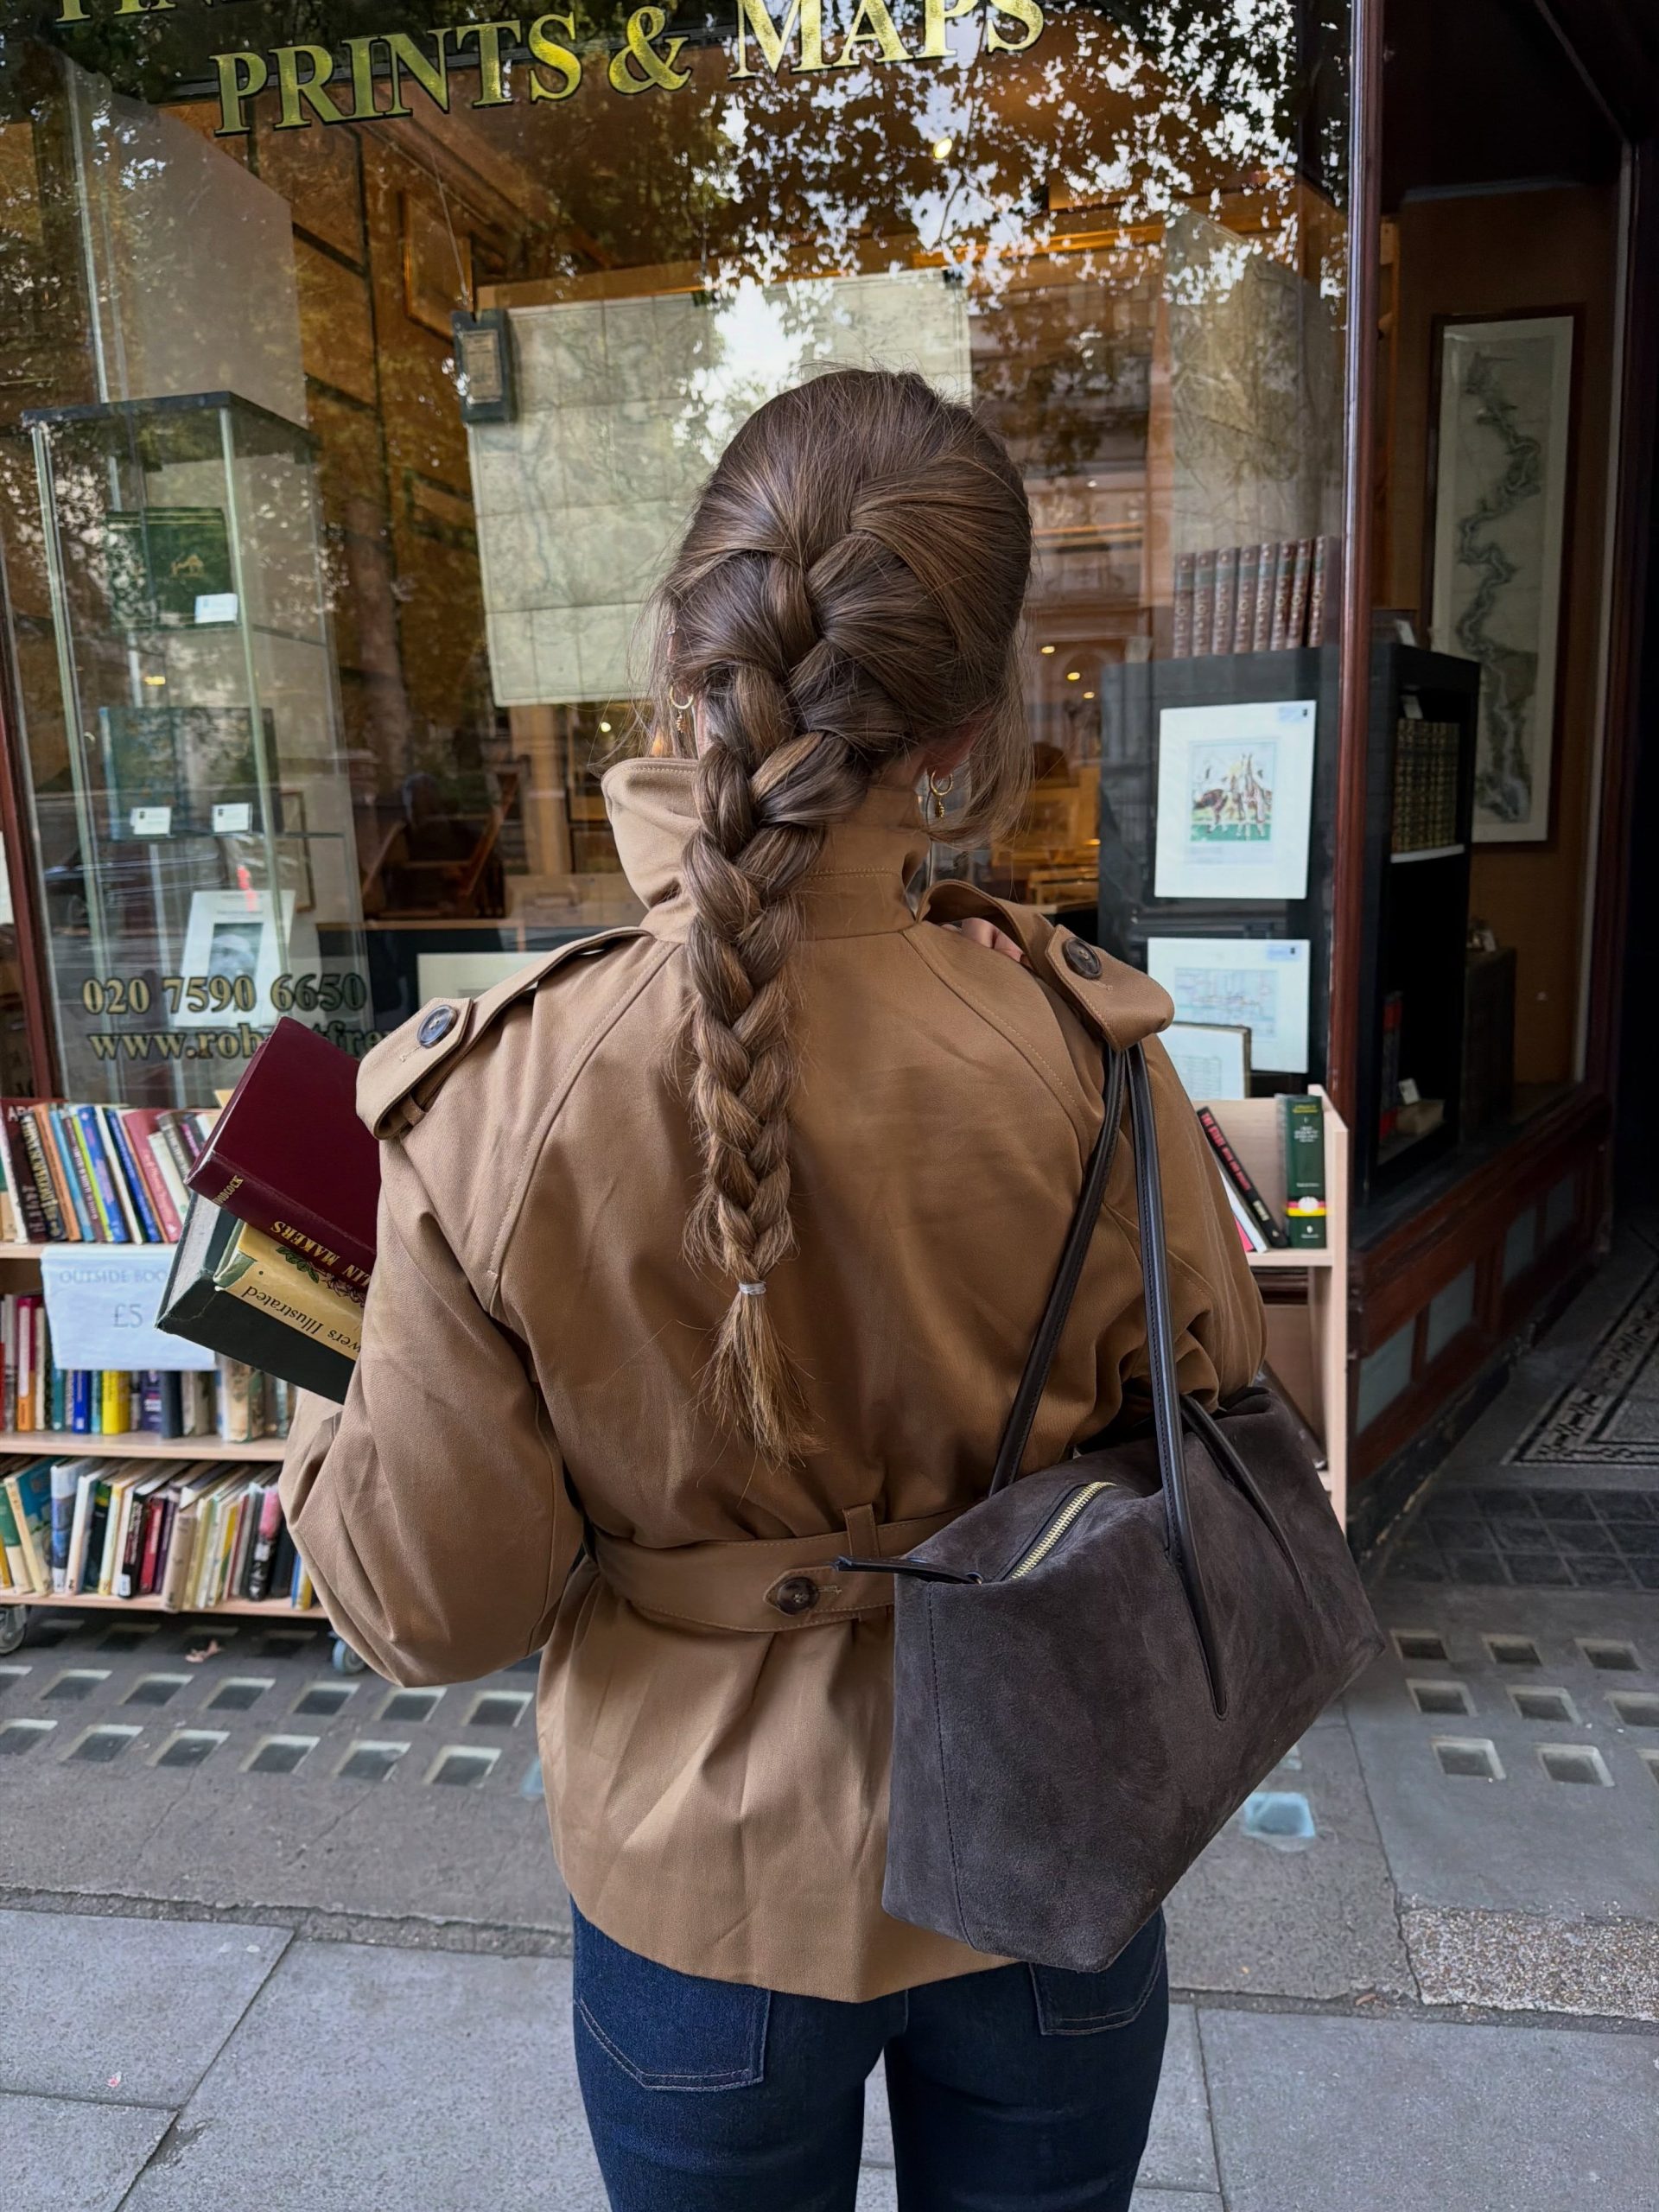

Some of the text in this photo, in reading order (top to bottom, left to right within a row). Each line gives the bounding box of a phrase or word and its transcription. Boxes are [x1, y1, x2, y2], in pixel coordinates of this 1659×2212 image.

[209, 0, 1046, 136] PRINTS & MAPS
[82, 973, 368, 1015] 020 7590 6650
[270, 1220, 340, 1267] MAKERS
[59, 1268, 168, 1285] OUTSIDE BOO
[113, 1303, 143, 1329] £5
[241, 1285, 361, 1354] wers Illustrated
